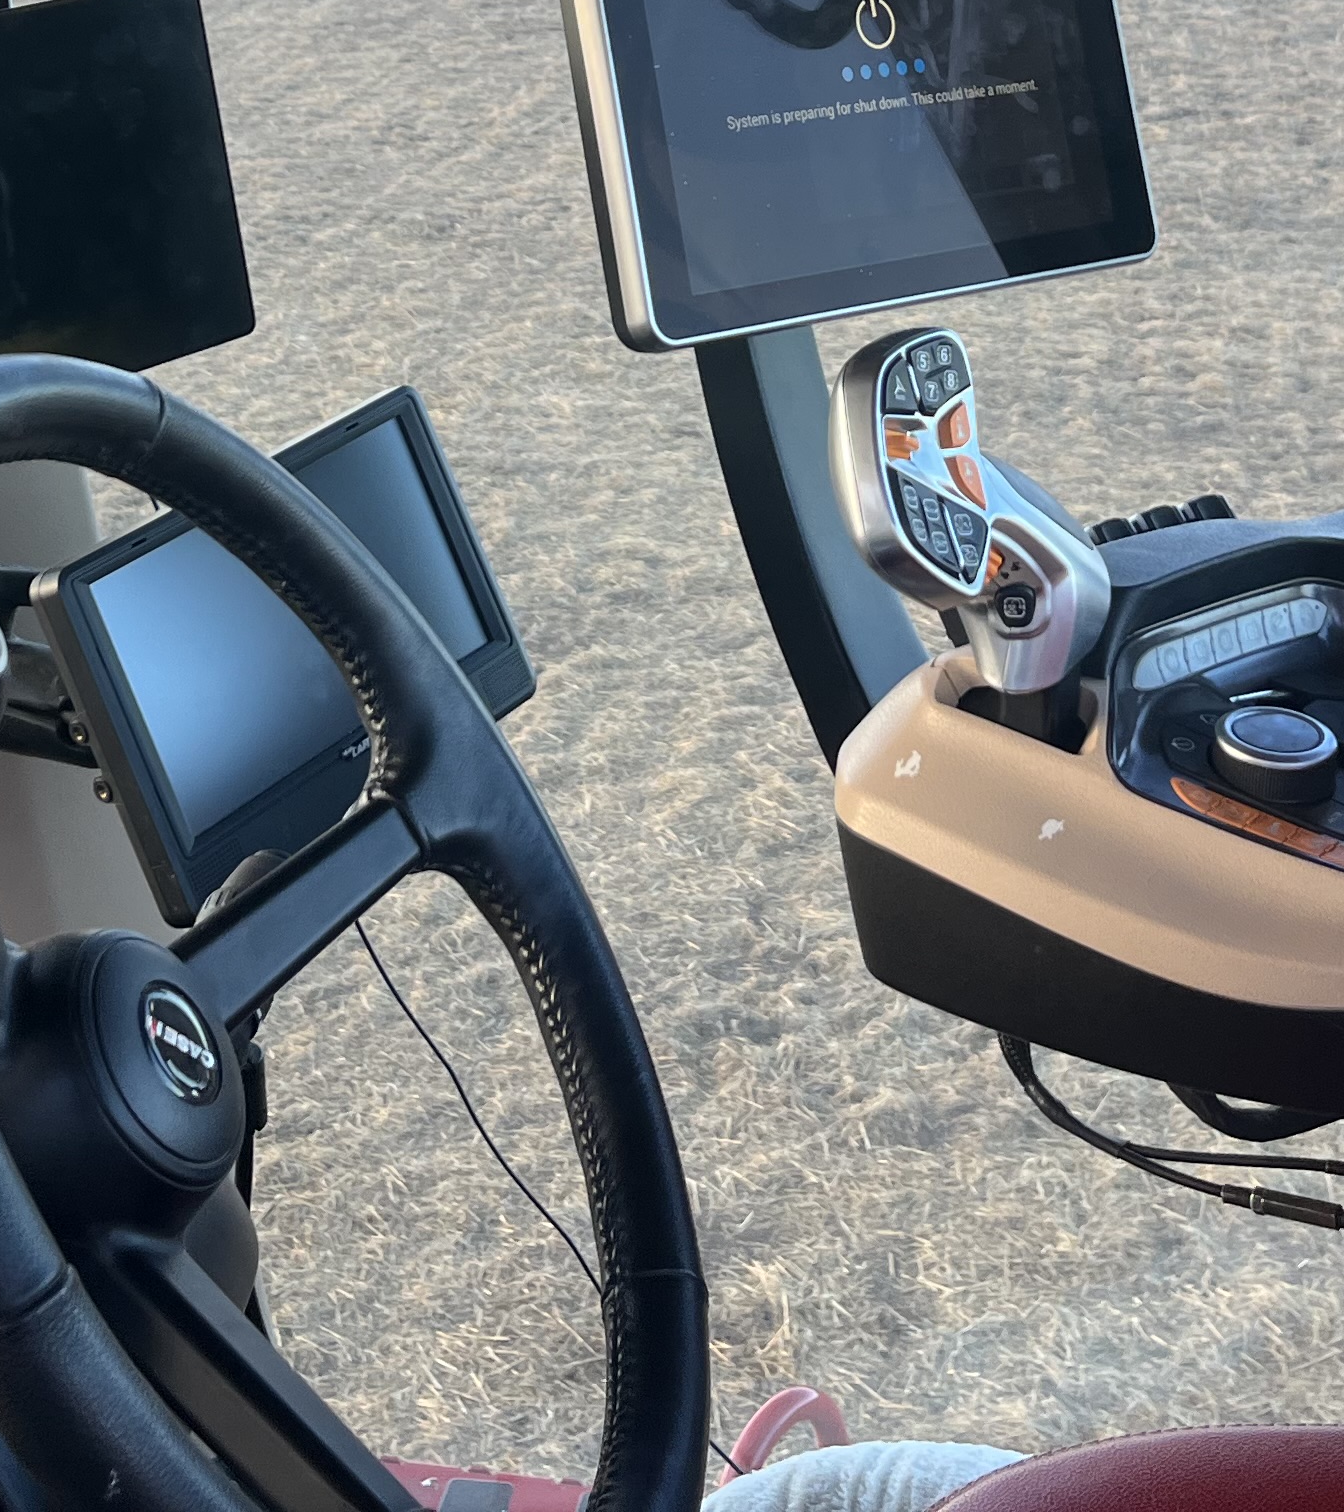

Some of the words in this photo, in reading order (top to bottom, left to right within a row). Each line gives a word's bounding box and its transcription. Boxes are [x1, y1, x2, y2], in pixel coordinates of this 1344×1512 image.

[726, 113, 770, 133] System
[771, 110, 782, 124] is
[783, 105, 836, 125] preparing
[836, 101, 852, 115] for
[853, 99, 878, 114] shut
[878, 95, 911, 110] down.
[911, 91, 934, 105] This
[935, 87, 963, 102] could
[964, 84, 986, 99] take
[995, 79, 1039, 96] moment.
